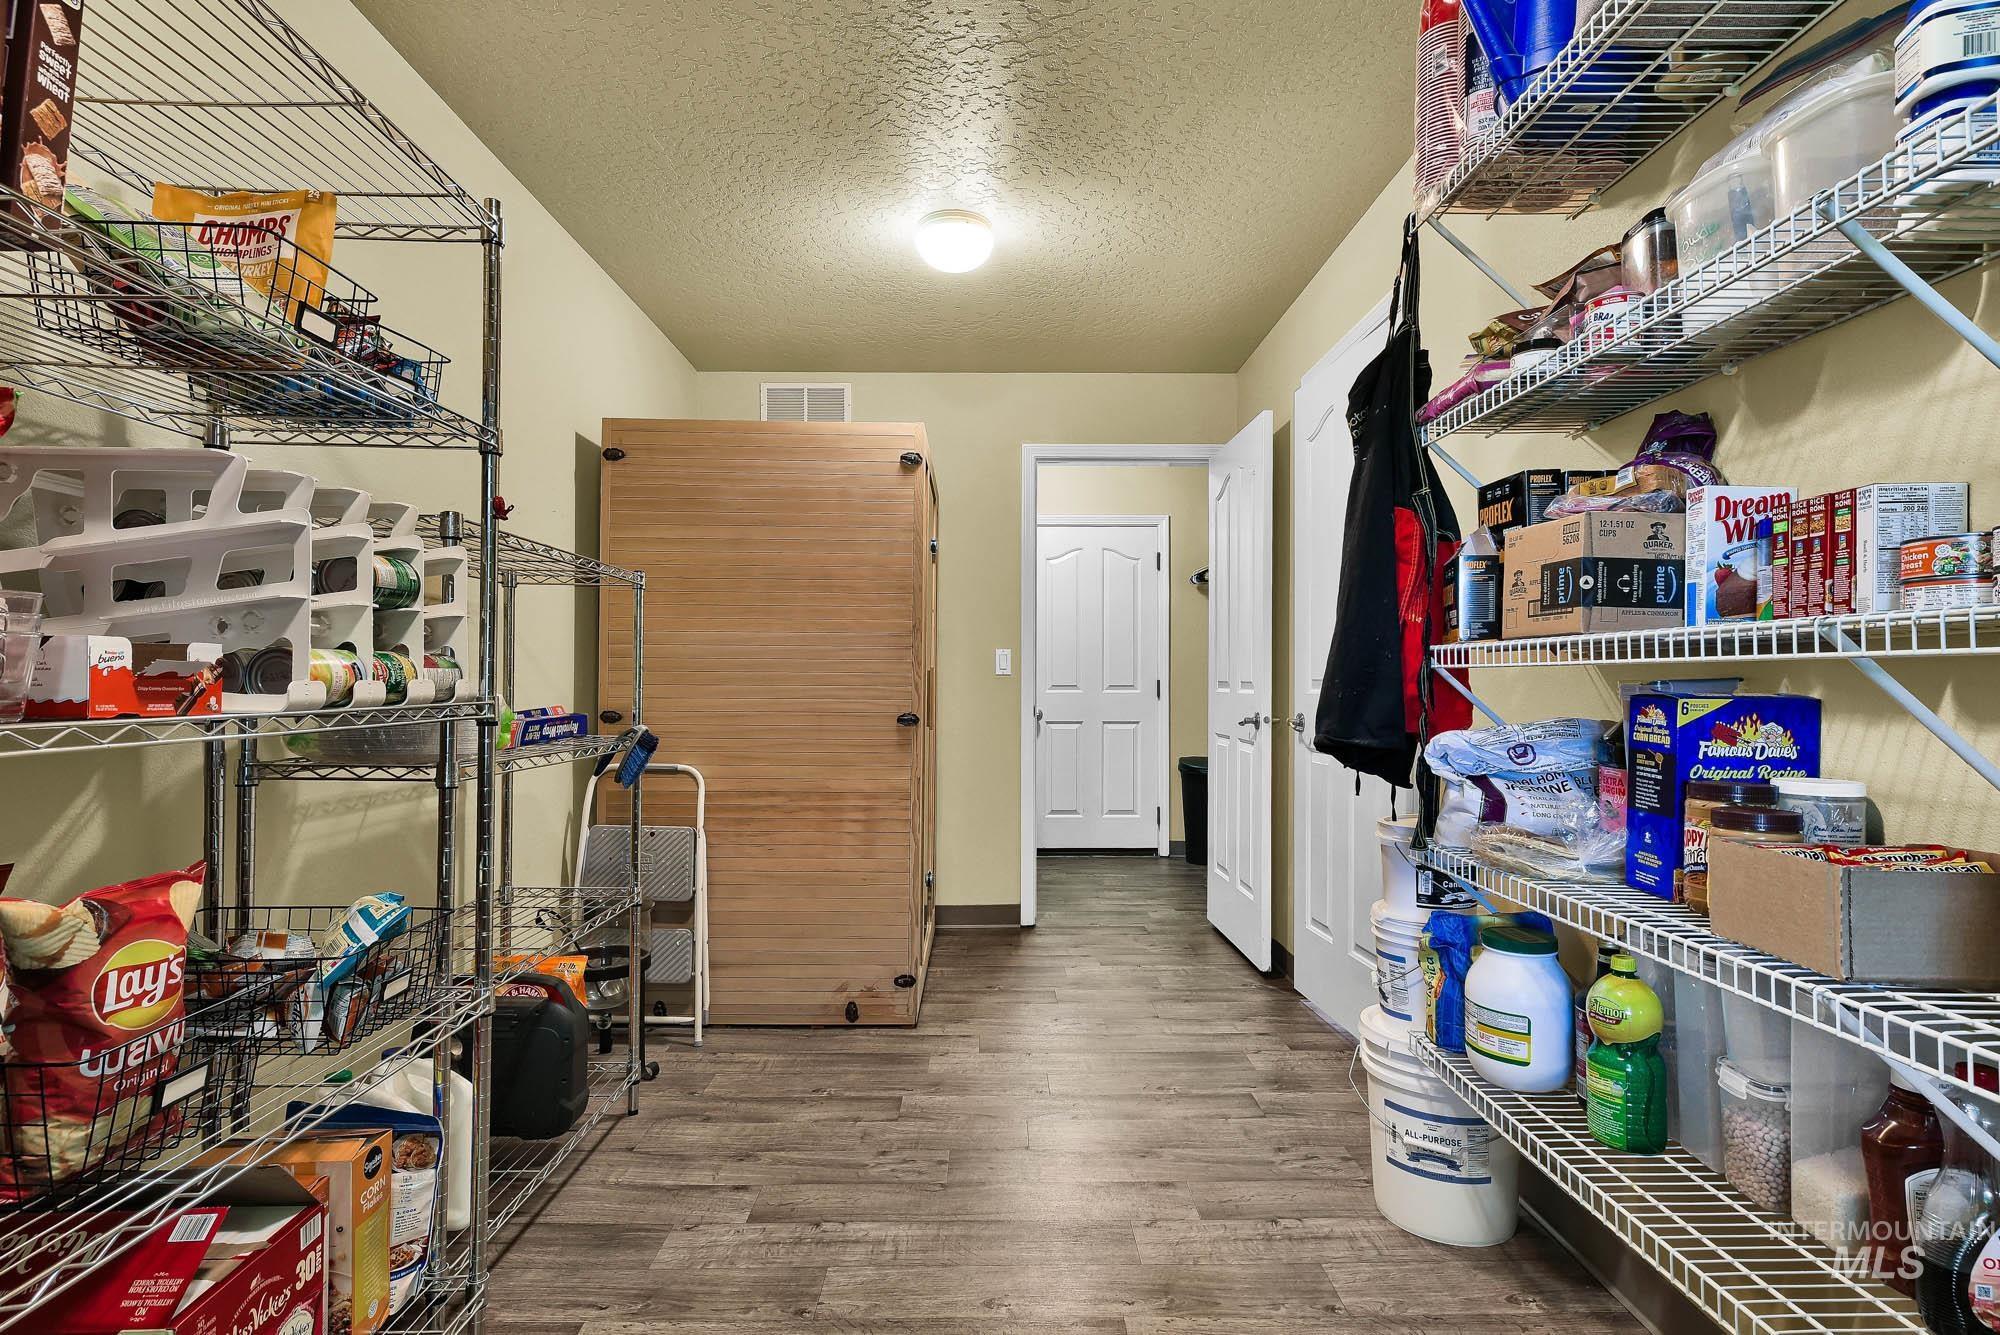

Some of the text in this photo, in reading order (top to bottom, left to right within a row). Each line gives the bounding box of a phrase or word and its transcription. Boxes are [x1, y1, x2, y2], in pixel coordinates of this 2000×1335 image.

[37, 72, 70, 103] wheat
[307, 190, 320, 199] 24
[198, 214, 292, 247] CHOMPS
[230, 262, 272, 277] TURKEY
[1530, 475, 1553, 483] PROFLEX
[1809, 497, 1825, 505] RICE
[1834, 492, 1850, 500] RICE
[1715, 492, 1791, 522] Dream
[1772, 506, 1787, 514] RICE
[1792, 501, 1807, 509] RICE
[1479, 497, 1514, 528] PROFLEX
[1599, 520, 1634, 528] 12-1.51 OZ
[1599, 529, 1616, 538] CUPS
[1643, 540, 1674, 549] QUAKER
[1901, 553, 1929, 561] Chicken
[1901, 561, 1923, 570] Breast
[1529, 578, 1541, 586] APPL
[1557, 567, 1567, 604] prime
[1655, 565, 1667, 603] prime
[1509, 586, 1527, 596] QUAKER
[98, 653, 125, 664] bueno
[1681, 701, 1689, 716] 6
[542, 720, 579, 738] Reynolds Wrap
[1633, 732, 1671, 746] CORN BREAD
[1698, 740, 1800, 761] Famous Dave's
[1689, 764, 1808, 781] Original Recipe
[1504, 779, 1573, 794] JASMINE
[1602, 776, 1625, 787] EXTRA
[1600, 786, 1626, 797] VIRGIN
[1684, 829, 1704, 848] PPY
[1781, 849, 1829, 863] uchan
[558, 962, 567, 970] 15
[103, 953, 184, 1014] Lay's
[80, 1017, 185, 1078] Wavy
[113, 1060, 169, 1092] Original
[1405, 1128, 1462, 1147] ALL-PURPOSE
[361, 1174, 386, 1205] CORN
[363, 1192, 383, 1214] Flakes
[295, 1250, 316, 1291] 30
[128, 1285, 180, 1294] NO COLORS FROM
[132, 1278, 184, 1287] ARTIFICIAL SOURCES
[144, 1299, 175, 1307] ARTIFICIAL
[250, 1285, 292, 1331] Vickie's
[135, 1306, 149, 1317] NO
